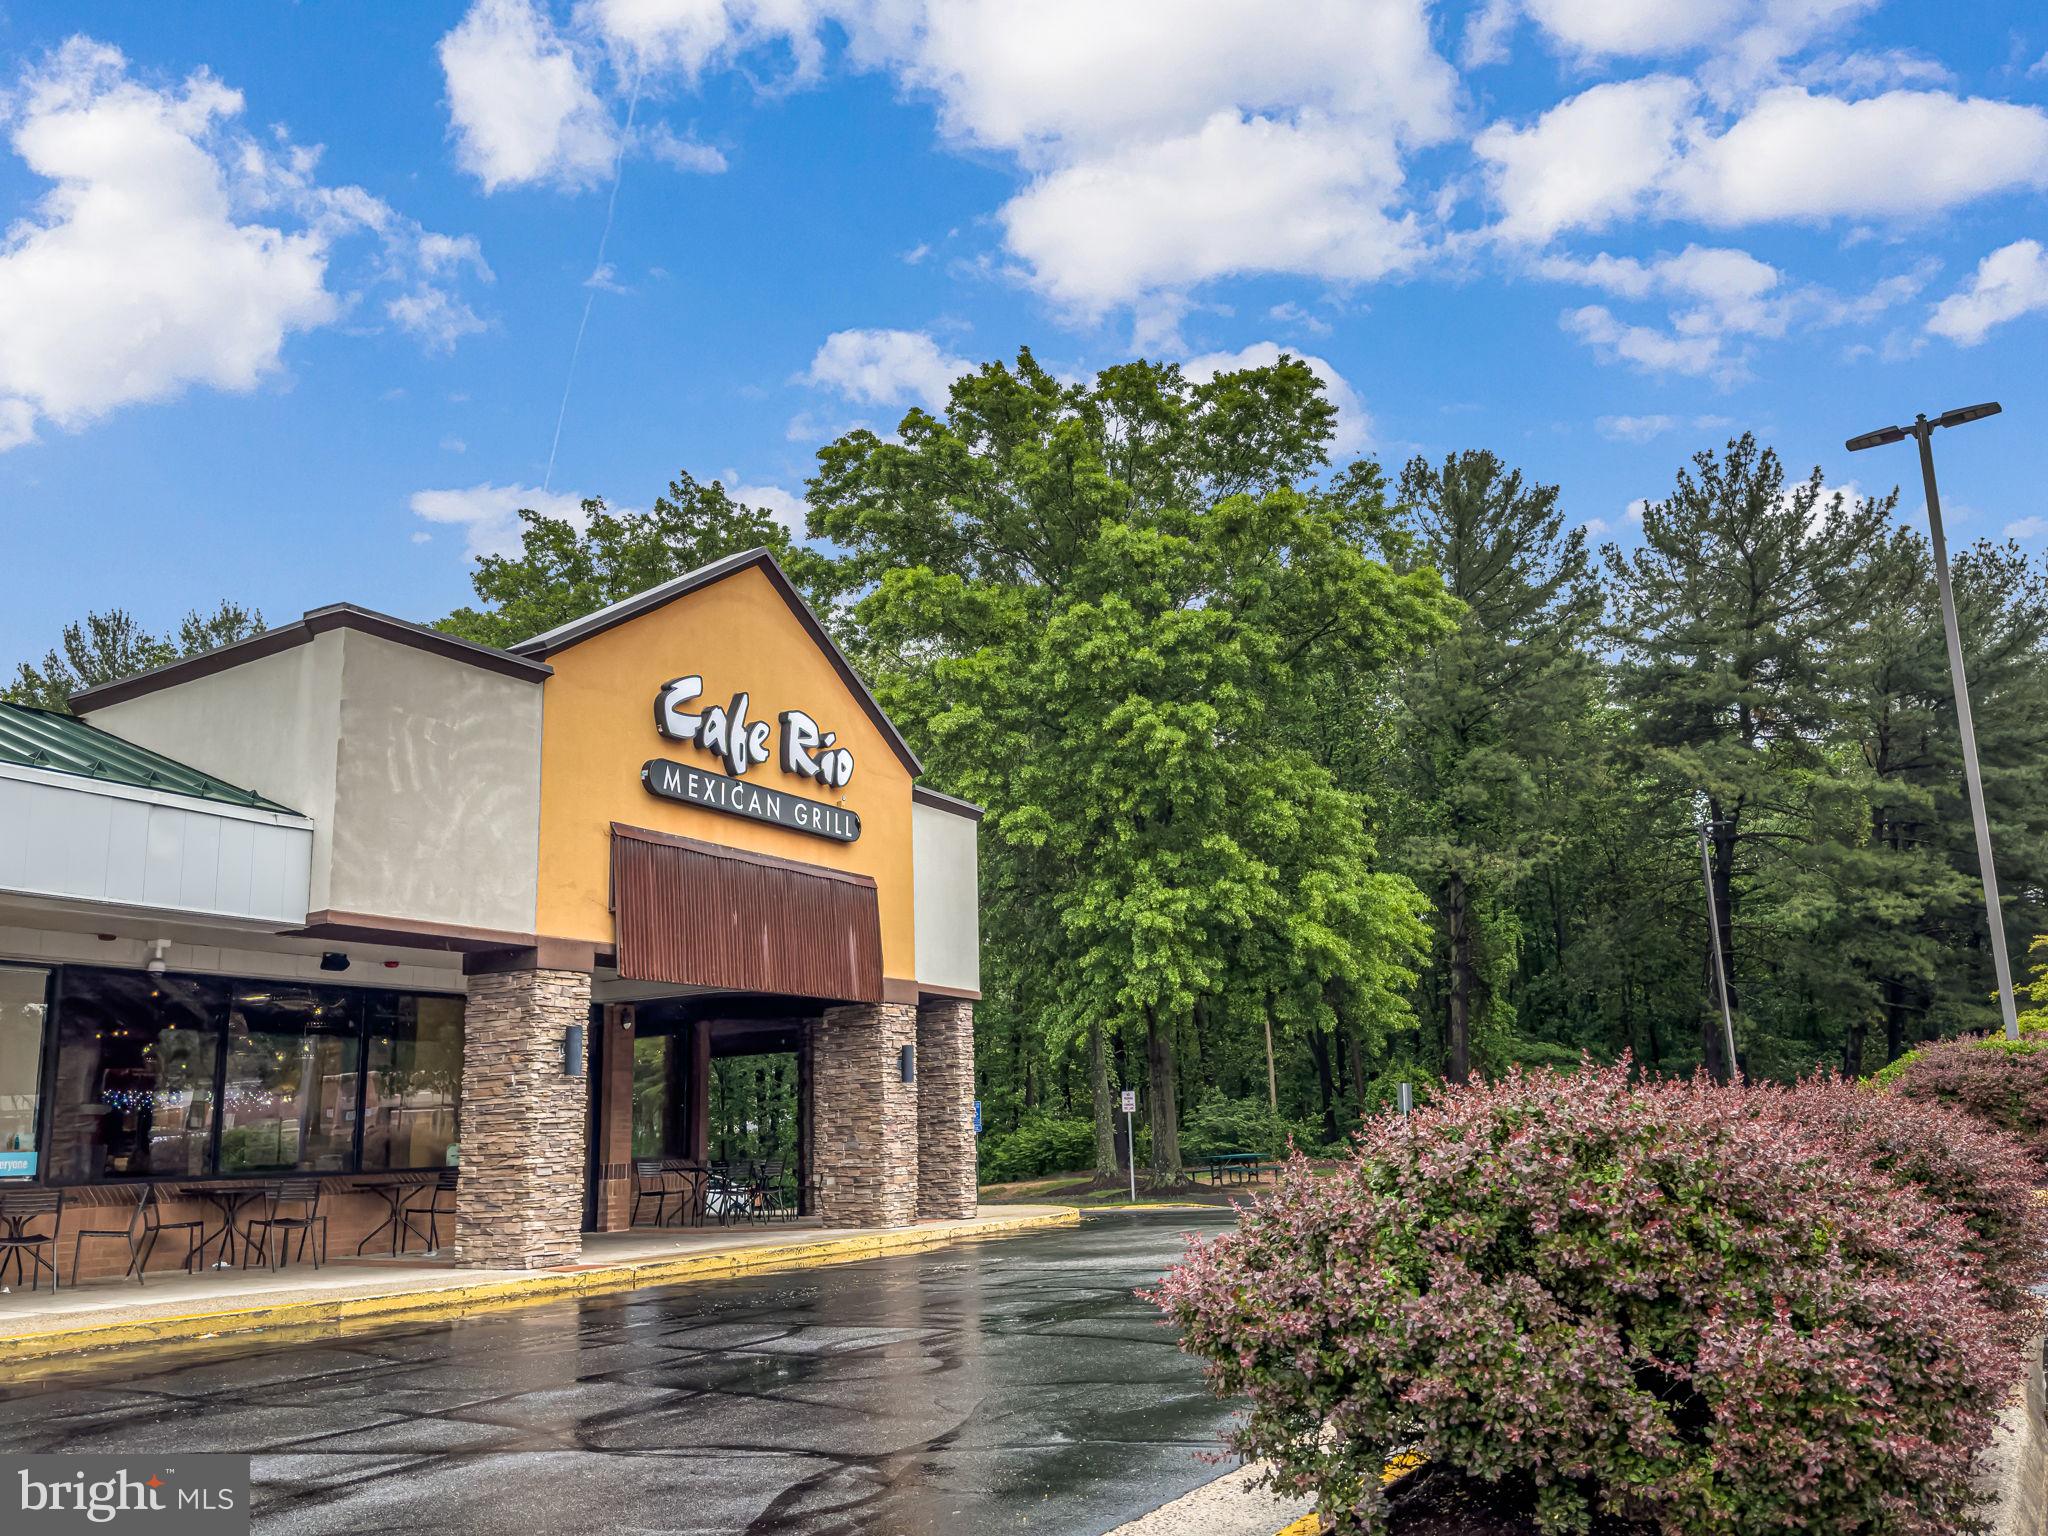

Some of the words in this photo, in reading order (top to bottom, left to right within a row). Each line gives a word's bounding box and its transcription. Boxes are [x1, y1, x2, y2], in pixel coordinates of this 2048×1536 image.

[654, 675, 770, 776] Cafe
[778, 710, 854, 788] Rio
[663, 765, 780, 821] MEXICAN
[794, 803, 852, 837] GRILL
